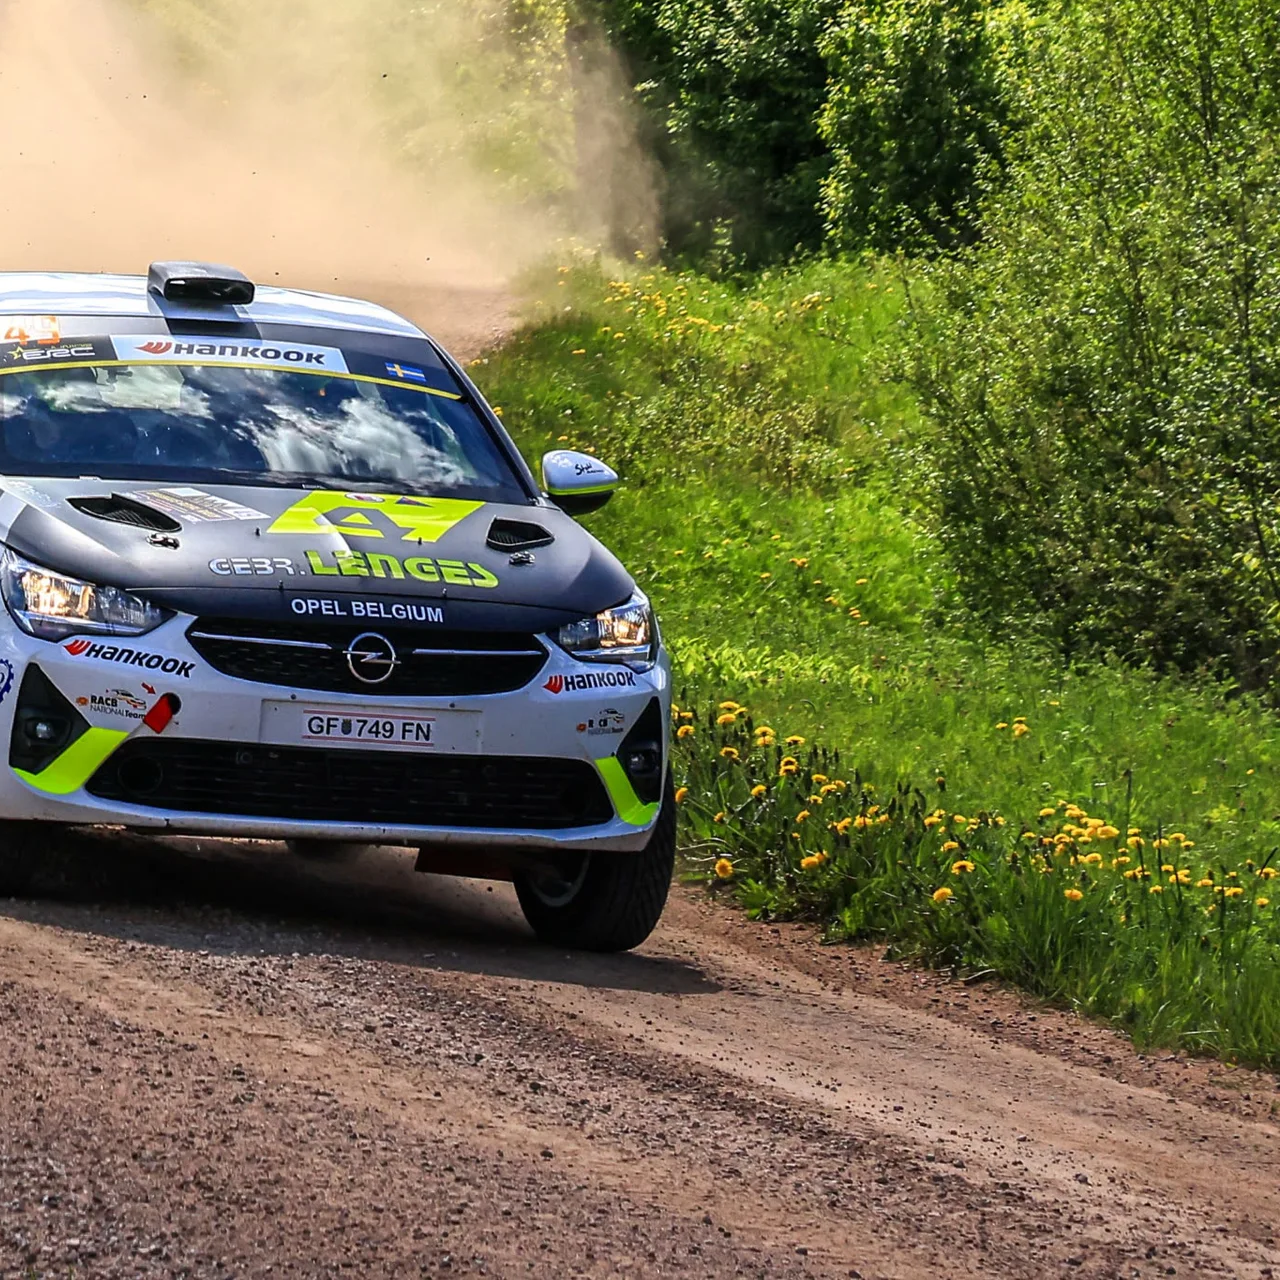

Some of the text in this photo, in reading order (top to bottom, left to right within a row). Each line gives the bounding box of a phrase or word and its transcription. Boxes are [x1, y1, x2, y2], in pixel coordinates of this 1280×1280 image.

[291, 598, 443, 623] OPEL BELGIUM
[90, 695, 118, 708] RACB
[307, 715, 431, 742] GF 749 FN
[588, 719, 608, 728] RCB
